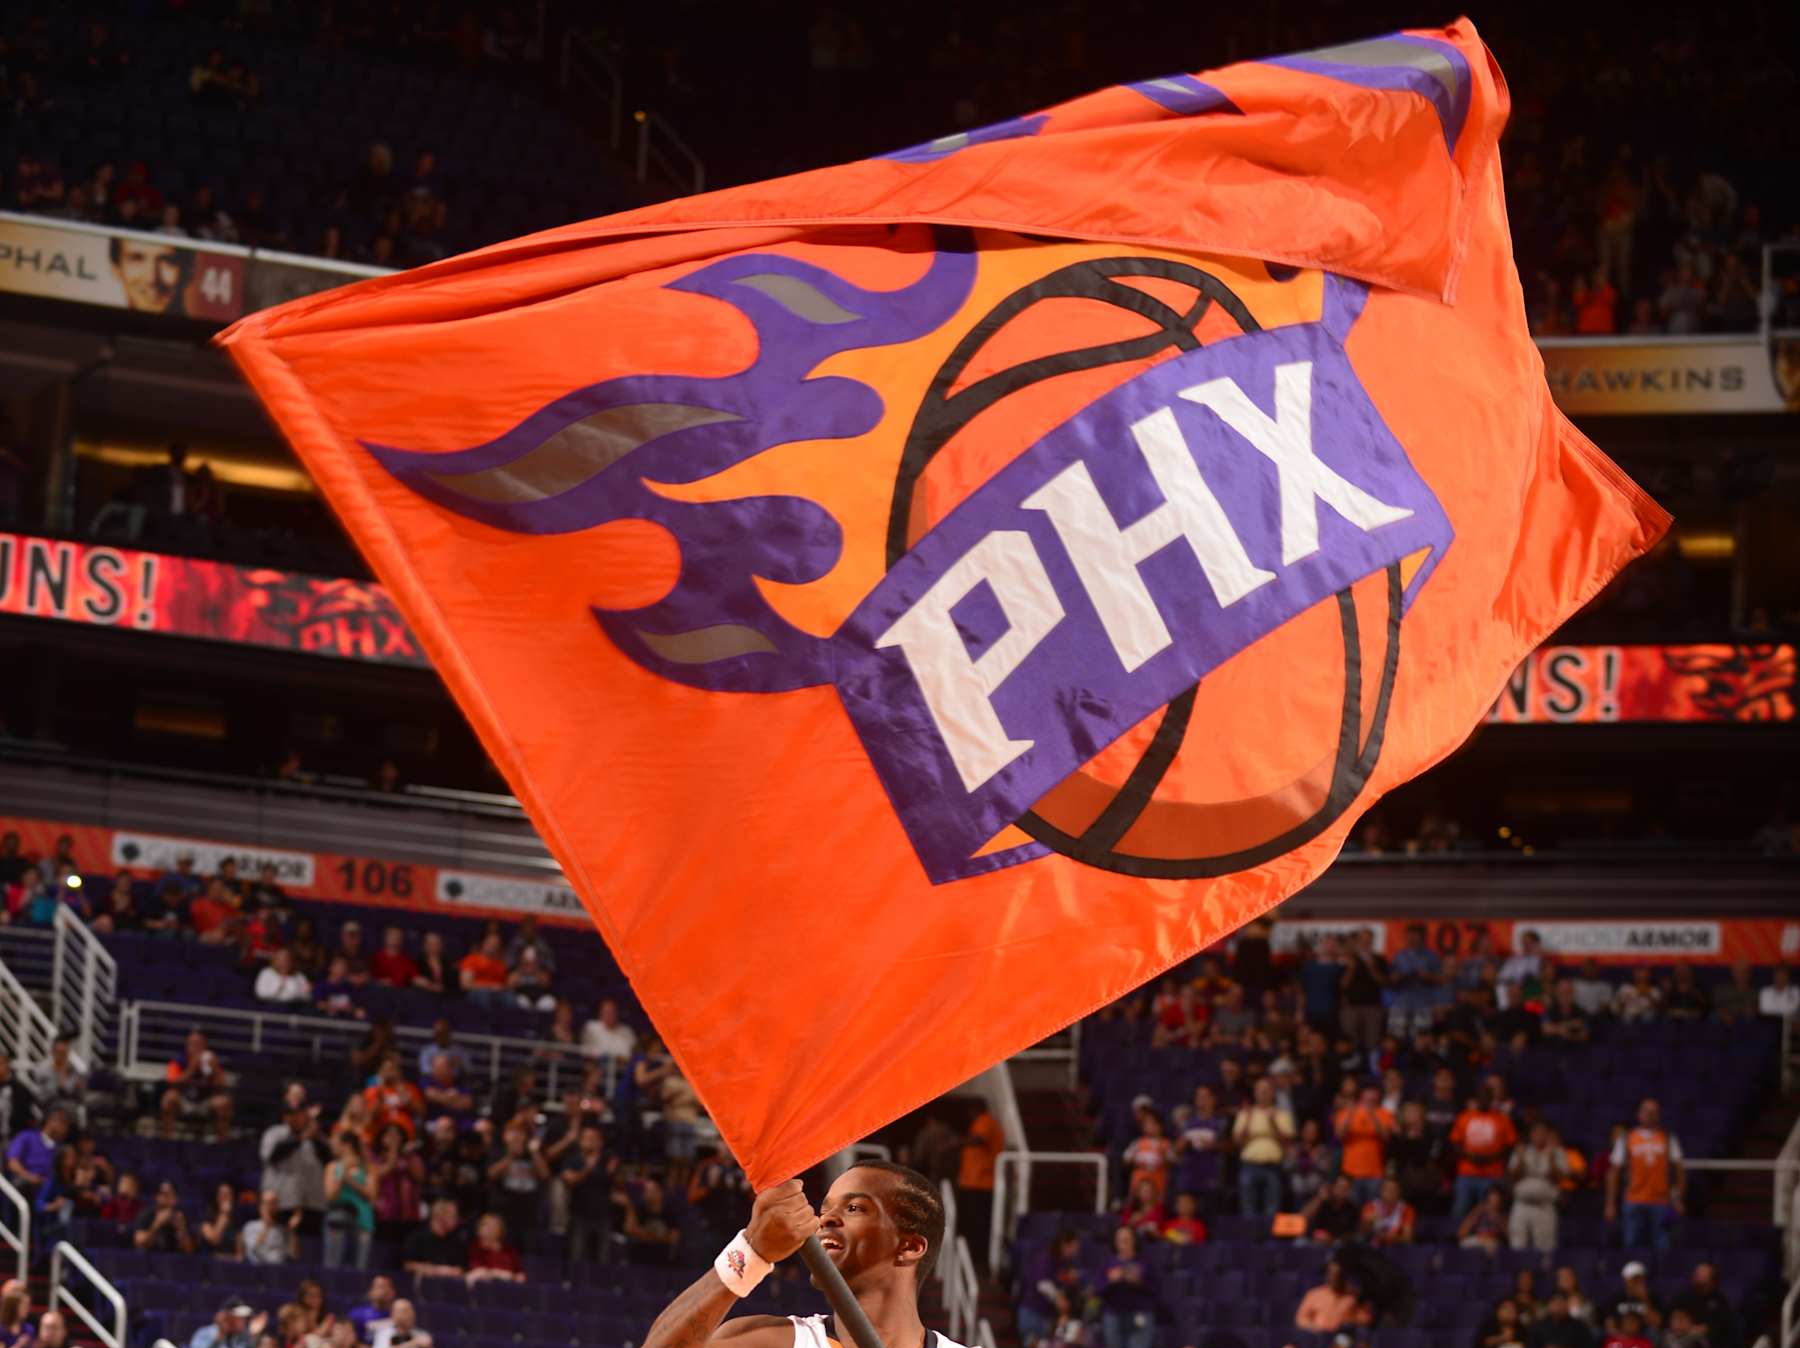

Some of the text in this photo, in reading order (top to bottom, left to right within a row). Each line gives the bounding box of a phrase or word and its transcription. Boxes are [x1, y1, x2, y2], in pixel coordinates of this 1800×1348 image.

[201, 266, 234, 305] 44
[875, 361, 1414, 793] PHX
[337, 859, 413, 897] 106
[1627, 930, 1711, 948] ARMOR
